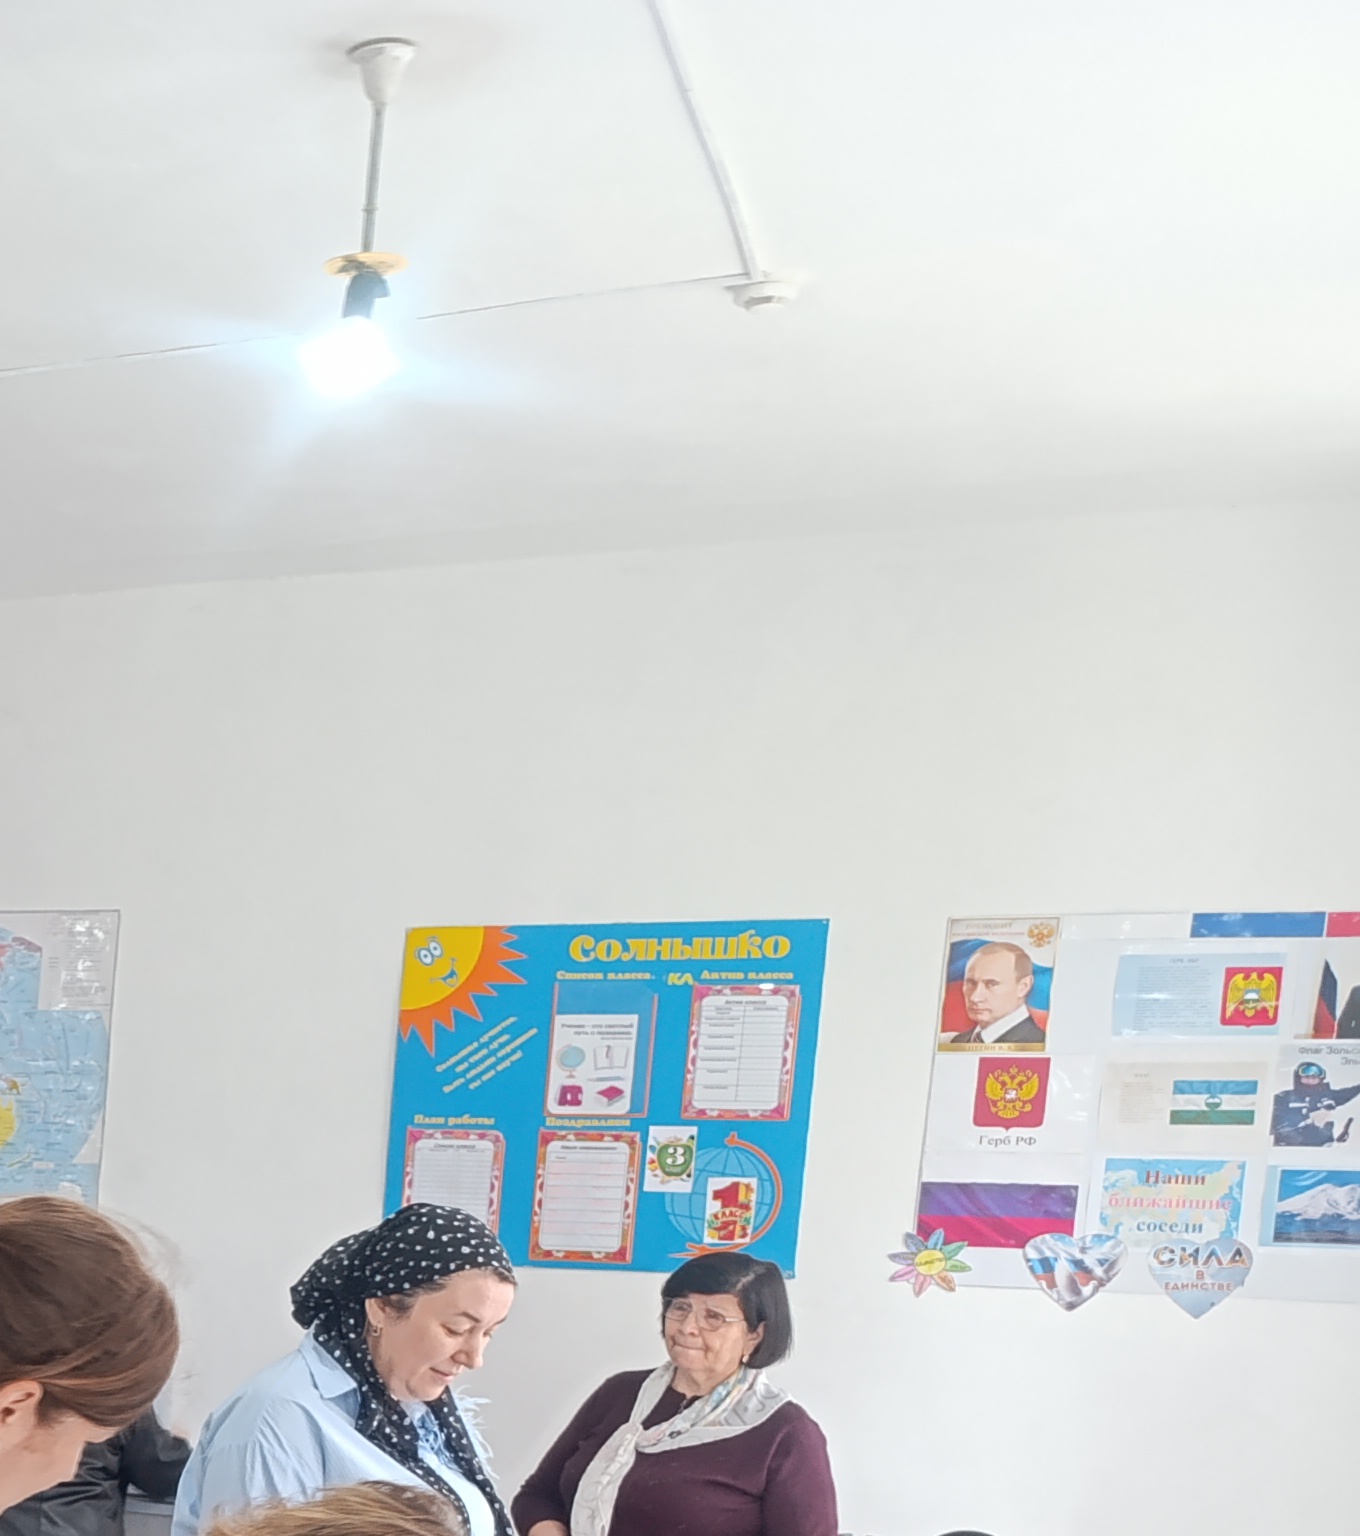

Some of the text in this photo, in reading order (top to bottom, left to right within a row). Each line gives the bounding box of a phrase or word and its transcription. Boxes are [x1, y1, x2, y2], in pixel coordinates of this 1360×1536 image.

[569, 929, 791, 962] Солнышко
[1326, 1045, 1360, 1055] Зольс
[1340, 1056, 1360, 1065] Эль
[979, 1135, 1037, 1148] Герб РФ
[665, 1146, 686, 1166] 3
[1145, 1169, 1207, 1186] Наши
[1108, 1192, 1233, 1211] ближайшие
[1136, 1221, 1204, 1234] соседи
[1153, 1245, 1249, 1268] СИЛА
[1196, 1269, 1205, 1280] В
[1164, 1281, 1232, 1292] ЕДИНСТВЕ
